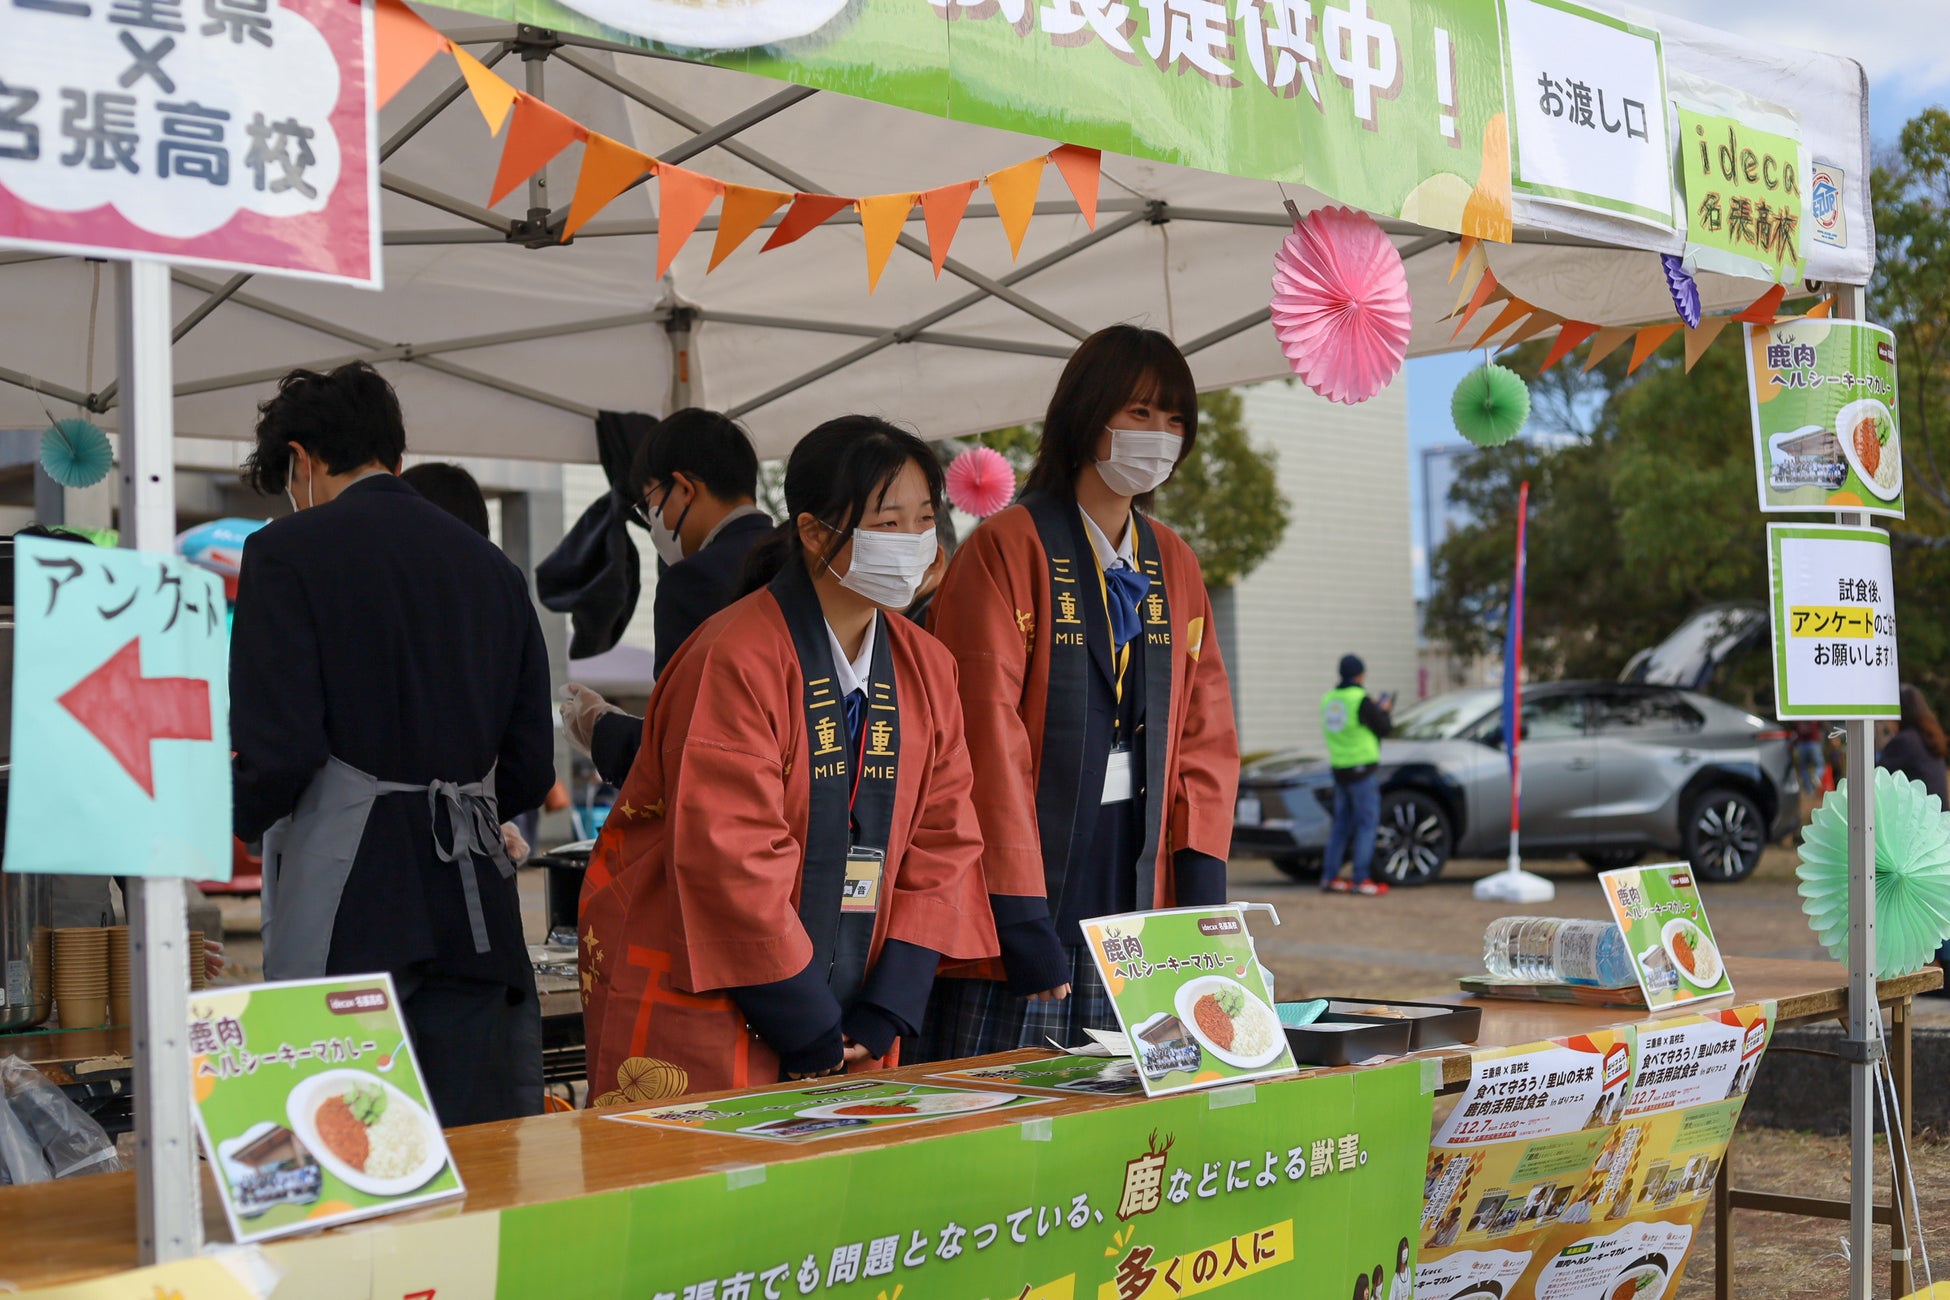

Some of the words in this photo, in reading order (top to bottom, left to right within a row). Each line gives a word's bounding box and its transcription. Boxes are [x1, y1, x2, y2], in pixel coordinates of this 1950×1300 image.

[1537, 71, 1649, 144] お渡し口
[0, 79, 318, 200] 名張高校
[1698, 190, 1799, 266] 名張高校
[1767, 343, 1817, 368] 鹿肉
[1769, 370, 1891, 394] ヘルシーキーマカレー
[33, 555, 219, 637] アンケート
[1052, 558, 1081, 624] 三重
[1144, 560, 1168, 624] 三重
[1838, 578, 1882, 603] 試食後、
[1055, 632, 1084, 645] MIE
[1147, 633, 1171, 645] MIE
[808, 678, 842, 756] 三重
[866, 682, 896, 756] 三重
[814, 761, 846, 779] MIE
[863, 765, 895, 779] MIE
[1102, 937, 1143, 962] 鹿肉
[1114, 954, 1234, 980] ヘルシーキーマカレー
[189, 1017, 243, 1053] 鹿肉
[199, 1040, 375, 1077] ヘルシーキーマカレー
[1642, 1038, 1737, 1070] 食べて守ろう！里山の未来
[1474, 1066, 1594, 1100] 食べて守ろう！里山の未来
[1482, 1066, 1501, 1079] 三重県
[1511, 1062, 1530, 1073] 高校生
[1635, 1062, 1700, 1088] 鹿肉活用試食会
[1463, 1092, 1549, 1117] 鹿肉活用試食会
[1459, 1120, 1492, 1134] 12.7
[1115, 1229, 1277, 1300] 多くの人に
